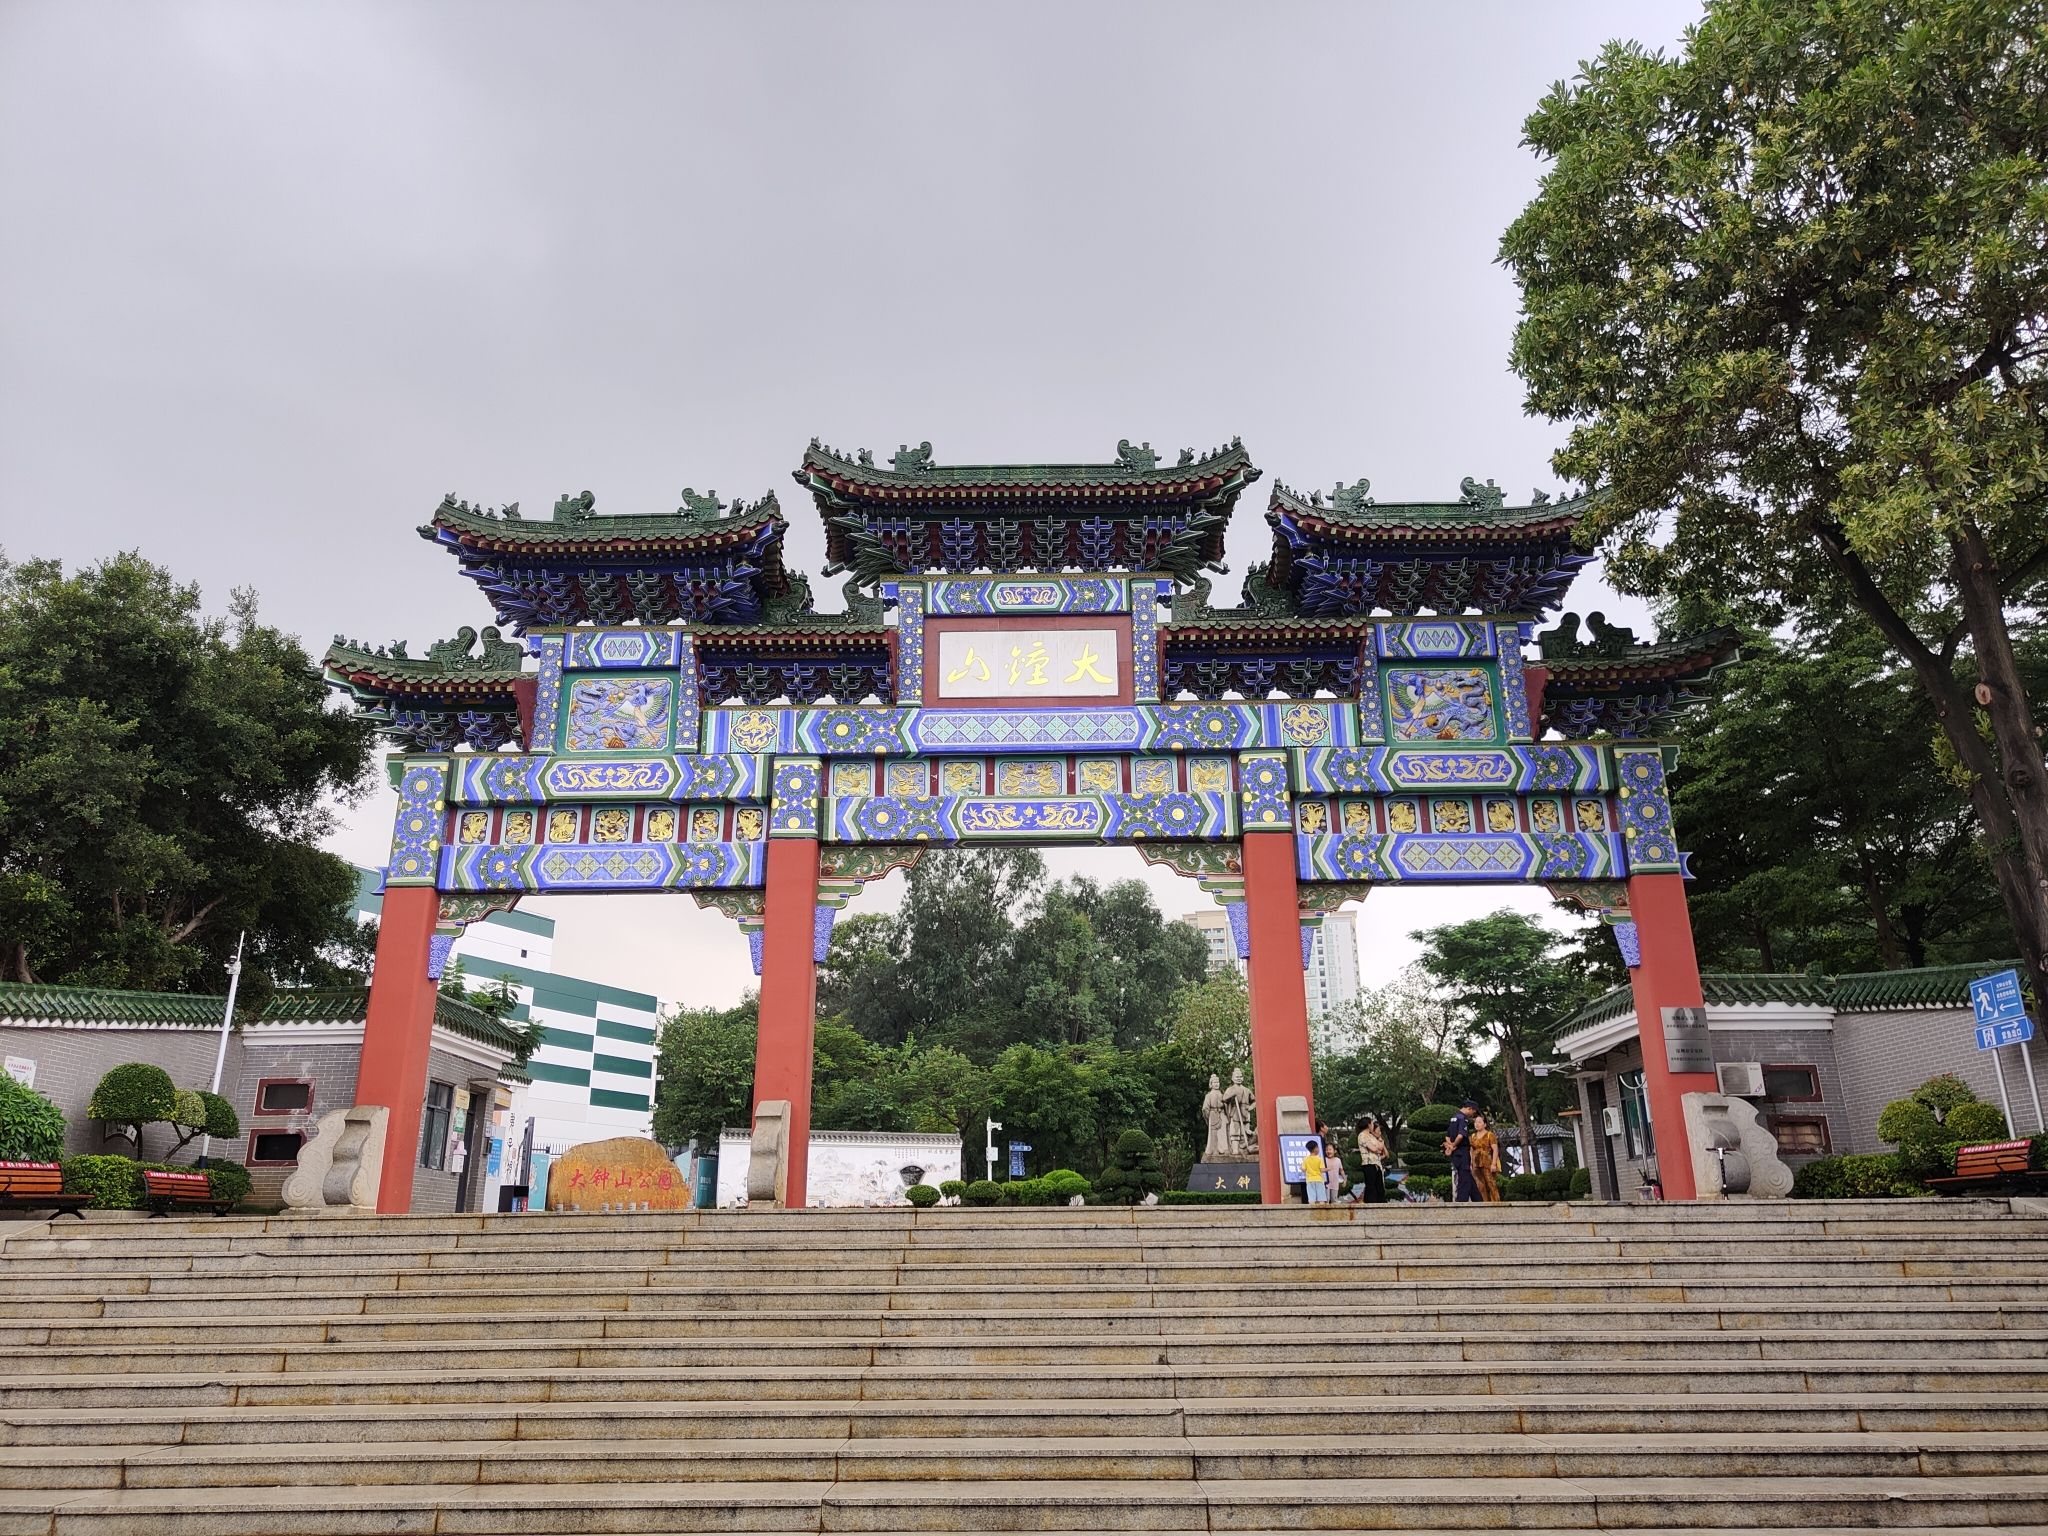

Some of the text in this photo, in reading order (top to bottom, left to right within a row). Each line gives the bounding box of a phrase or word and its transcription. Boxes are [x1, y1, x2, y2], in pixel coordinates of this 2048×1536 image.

[568, 1168, 672, 1190] 大钟山公园
